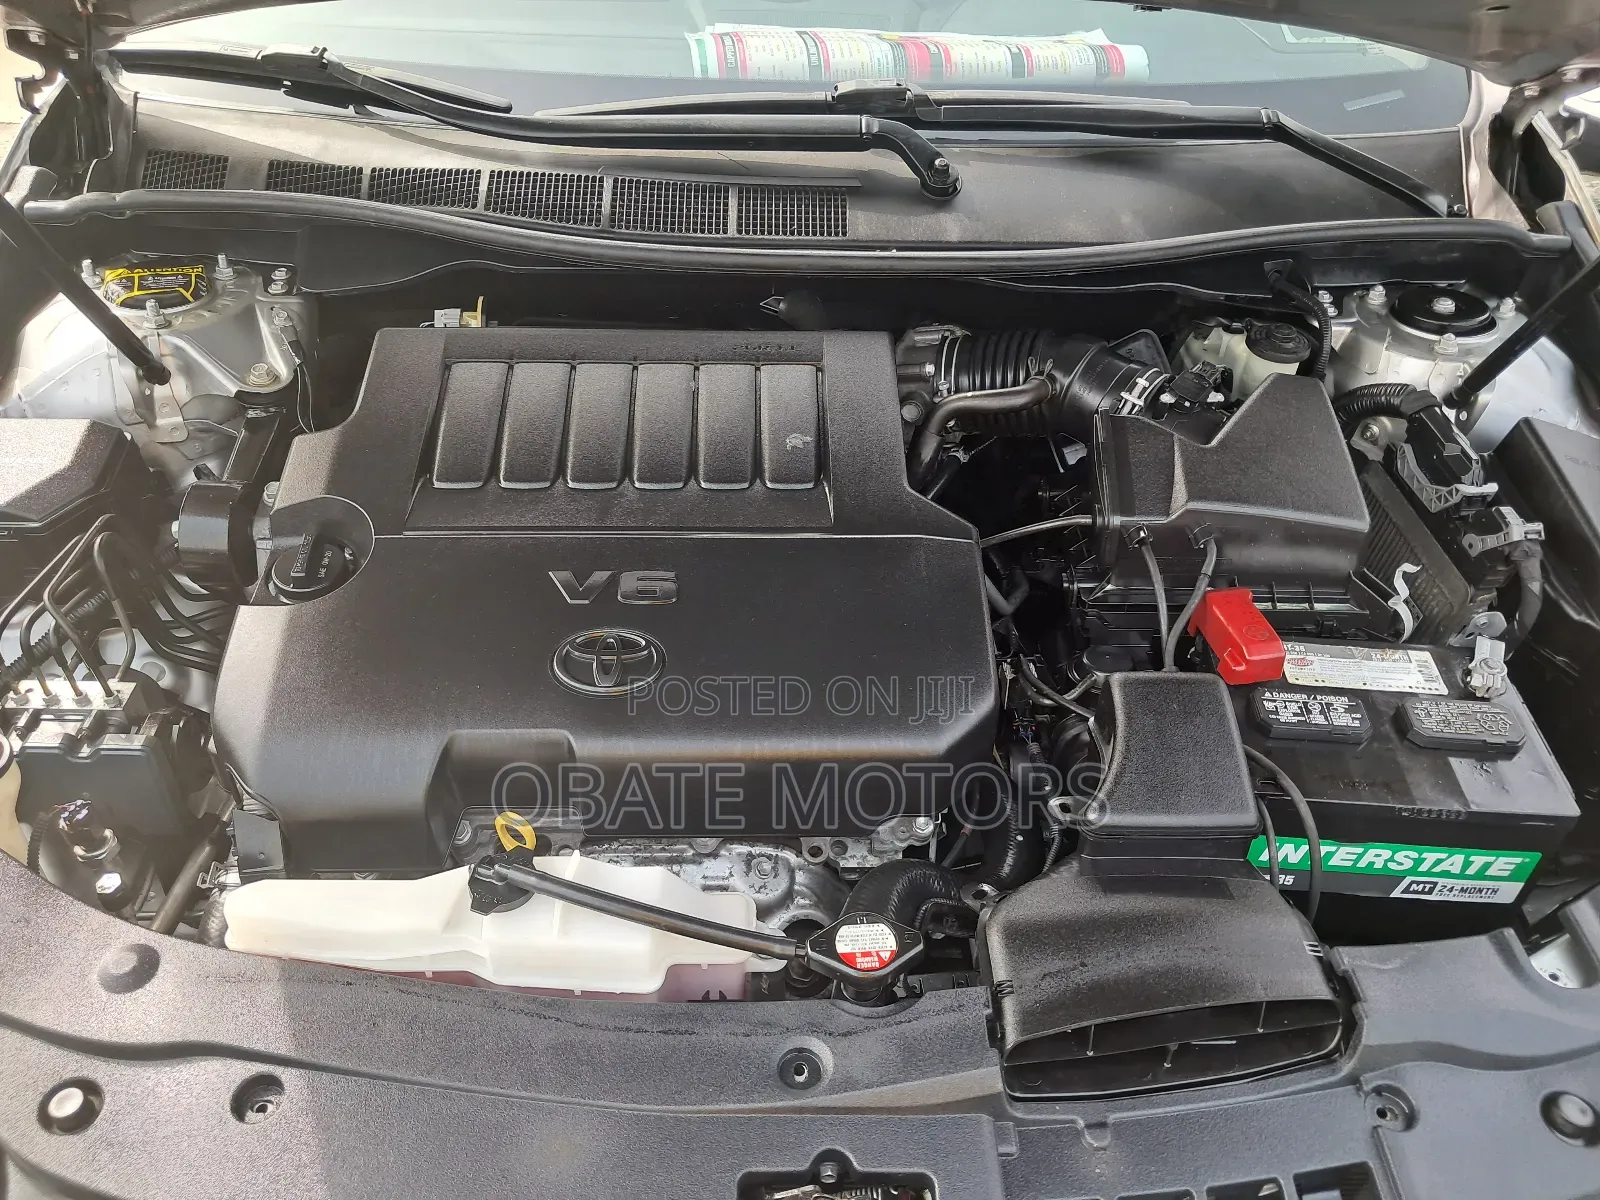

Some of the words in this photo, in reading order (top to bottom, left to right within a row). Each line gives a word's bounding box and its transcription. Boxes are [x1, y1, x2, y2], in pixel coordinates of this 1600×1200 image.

[547, 570, 679, 605] V6
[1272, 691, 1308, 700] DANGER
[1316, 694, 1349, 703] POISON
[1409, 883, 1434, 893] MT
[1437, 884, 1500, 896] 24-MONTH
